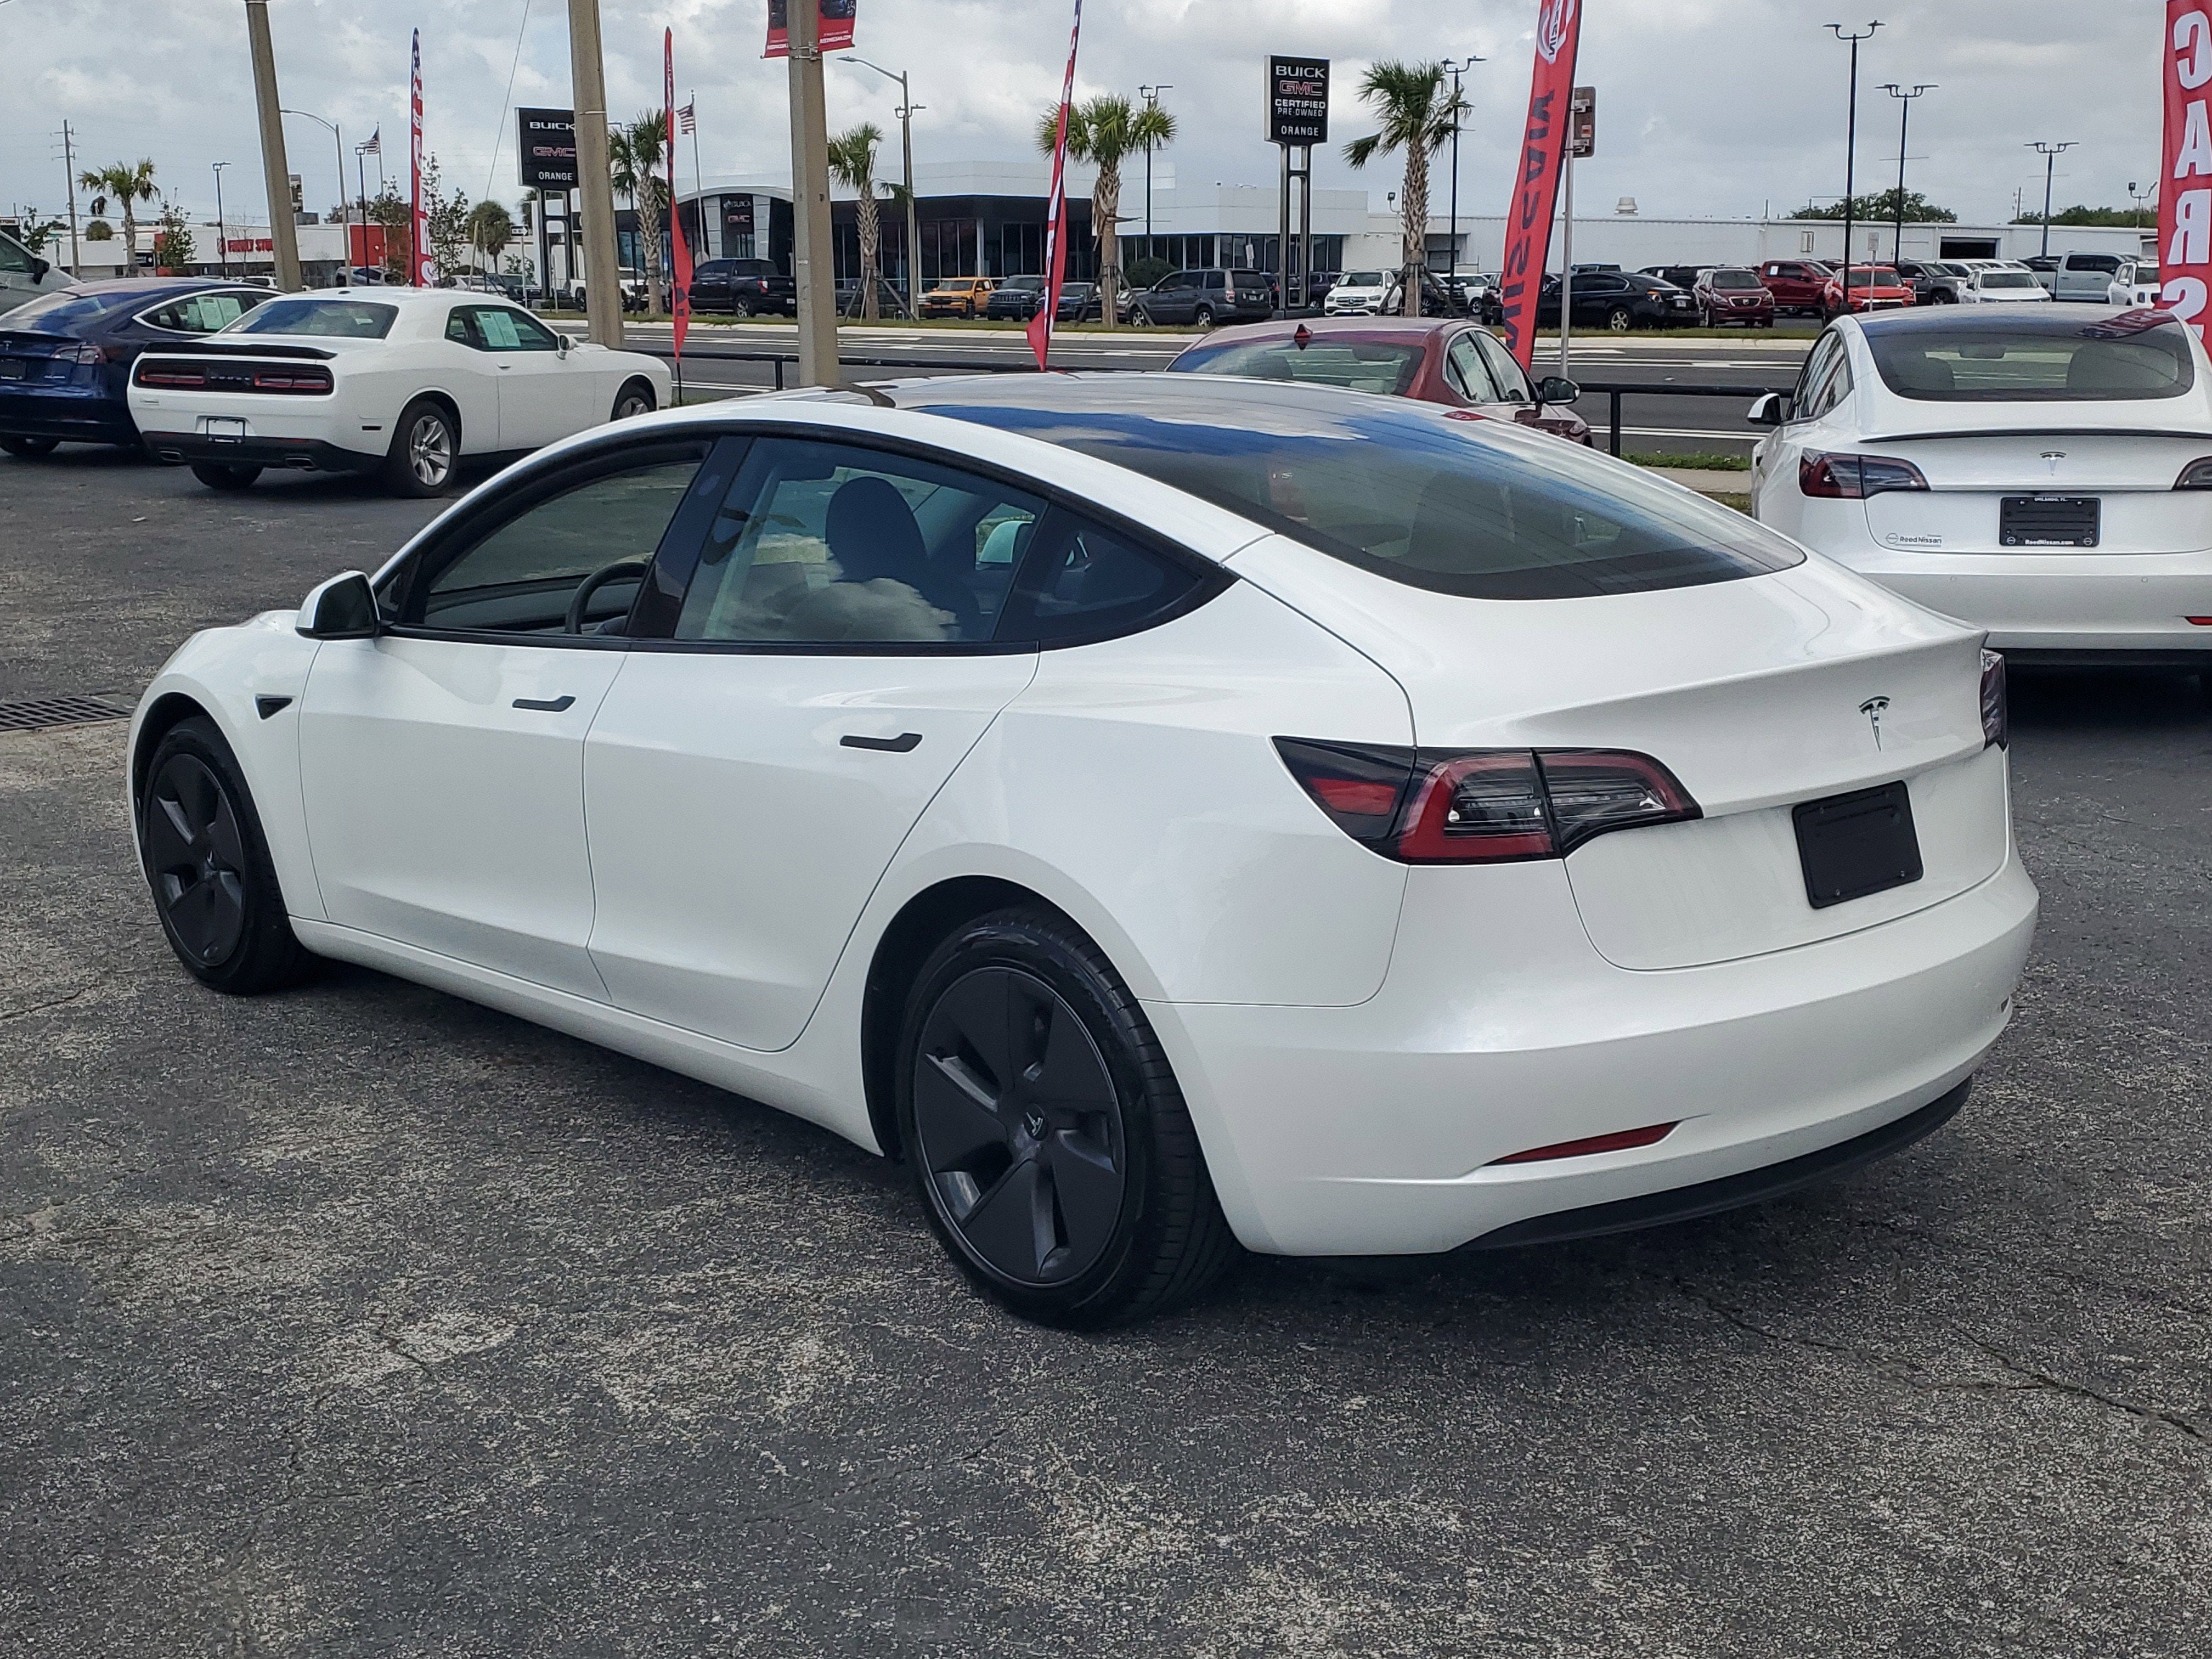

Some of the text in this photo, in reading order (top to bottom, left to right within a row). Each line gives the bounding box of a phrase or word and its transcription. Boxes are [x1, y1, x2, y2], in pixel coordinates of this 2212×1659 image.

[1276, 65, 1325, 78] BUICK
[1279, 80, 1324, 96] GMC
[1274, 98, 1326, 109] CERTIFIED
[529, 121, 576, 131] BUICK
[1280, 125, 1319, 136] ORANGE
[533, 146, 576, 157] GMC
[538, 171, 573, 180] ORANGE
